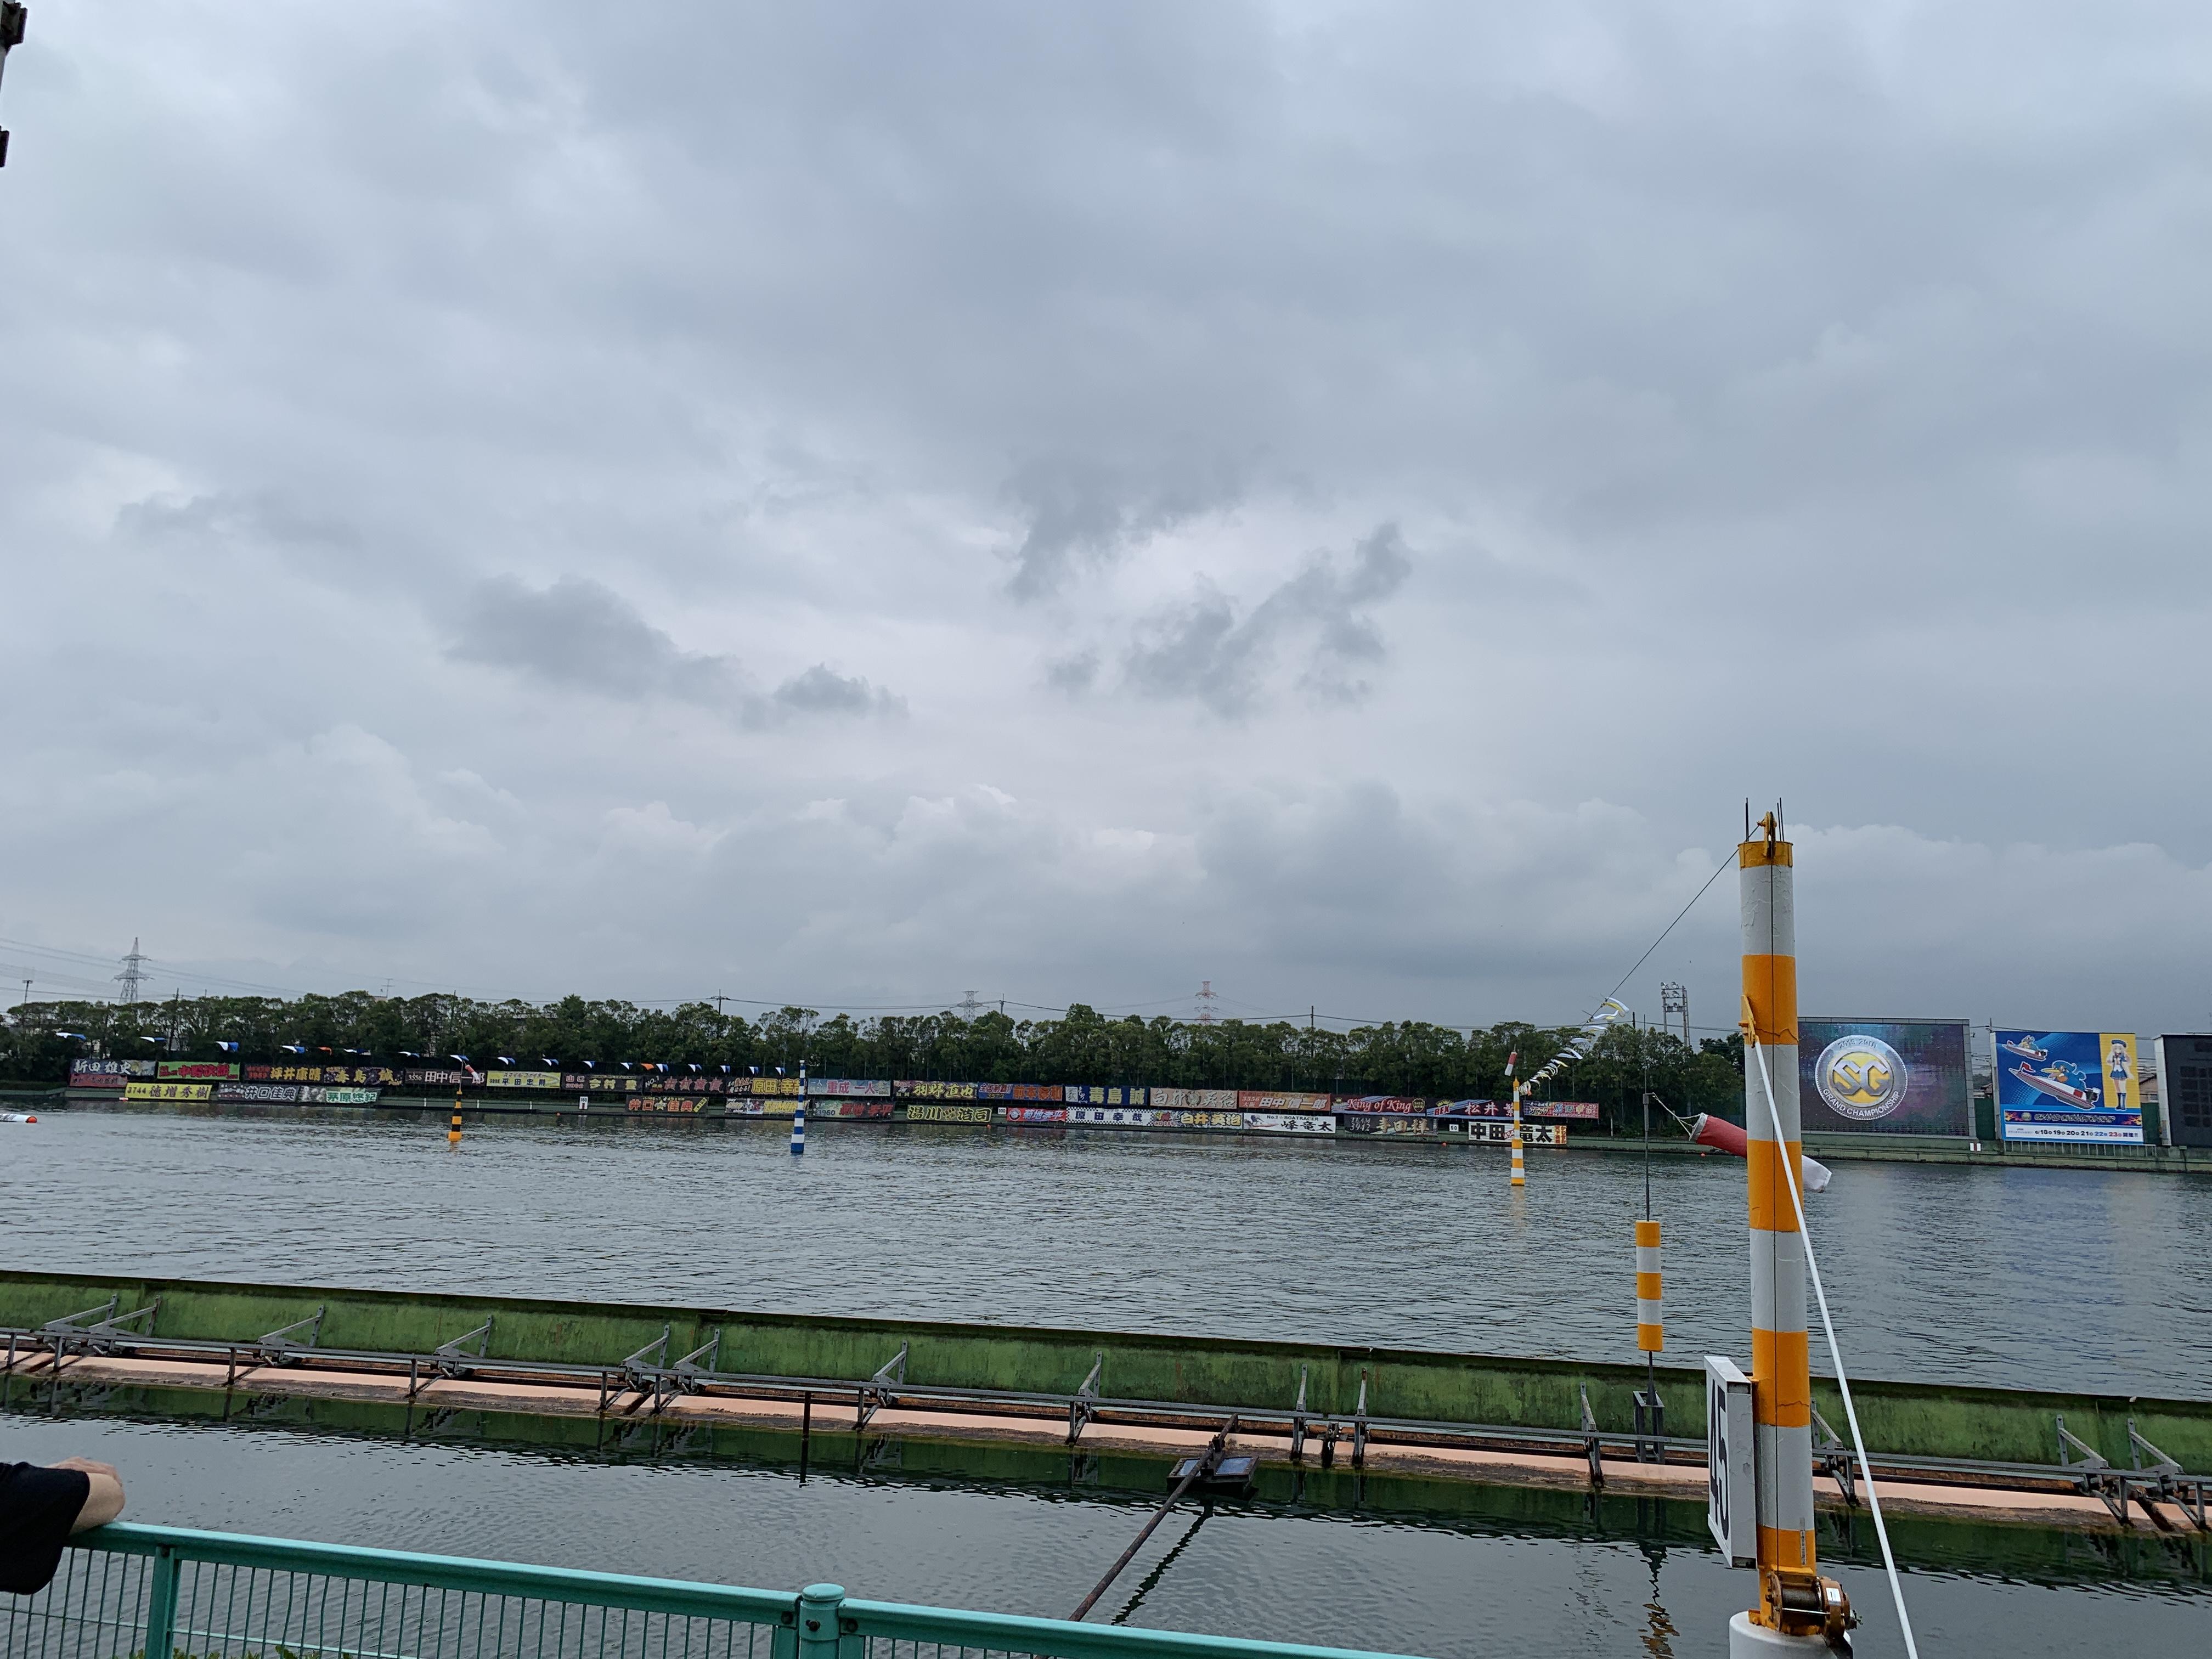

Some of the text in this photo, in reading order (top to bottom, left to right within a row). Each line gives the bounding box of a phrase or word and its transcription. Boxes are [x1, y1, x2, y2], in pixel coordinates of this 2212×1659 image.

[752, 1077, 778, 1095] 原田
[1833, 1060, 1891, 1096] SG
[245, 1086, 296, 1100] 井口佳典
[1347, 1098, 1412, 1114] King of King
[1434, 1105, 1450, 1116] REX
[1823, 1088, 1900, 1116] GRAND CHAMPIONSHIP
[908, 1105, 941, 1120] 湯川
[957, 1107, 992, 1122] 浩司
[1180, 1113, 1242, 1126] 白井英治
[1710, 1379, 1729, 1540] 45
